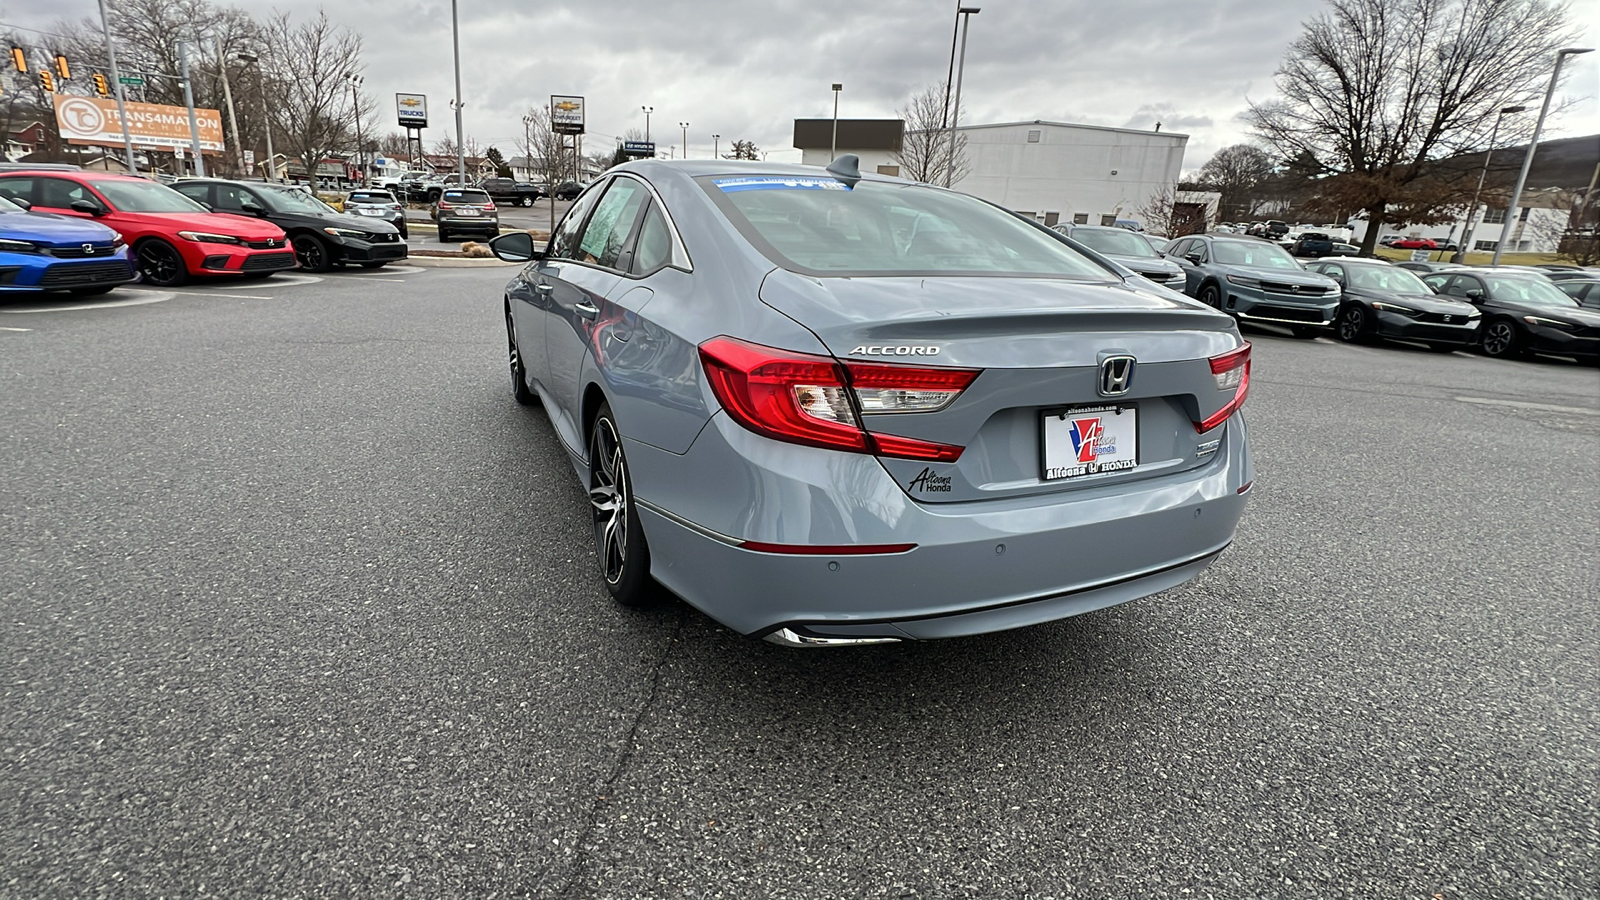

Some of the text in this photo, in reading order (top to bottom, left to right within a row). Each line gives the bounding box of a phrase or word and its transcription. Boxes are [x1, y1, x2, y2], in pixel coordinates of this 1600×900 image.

[104, 108, 219, 129] TRANS4MATON
[399, 109, 424, 117] TRUCKS
[849, 345, 940, 356] ACCORD
[1067, 405, 1117, 414] altoonahonda.com
[1093, 444, 1116, 455] Honda
[1047, 459, 1138, 479] Altoona HONDA
[908, 466, 952, 492] Altoona
[926, 484, 952, 492] Honda
